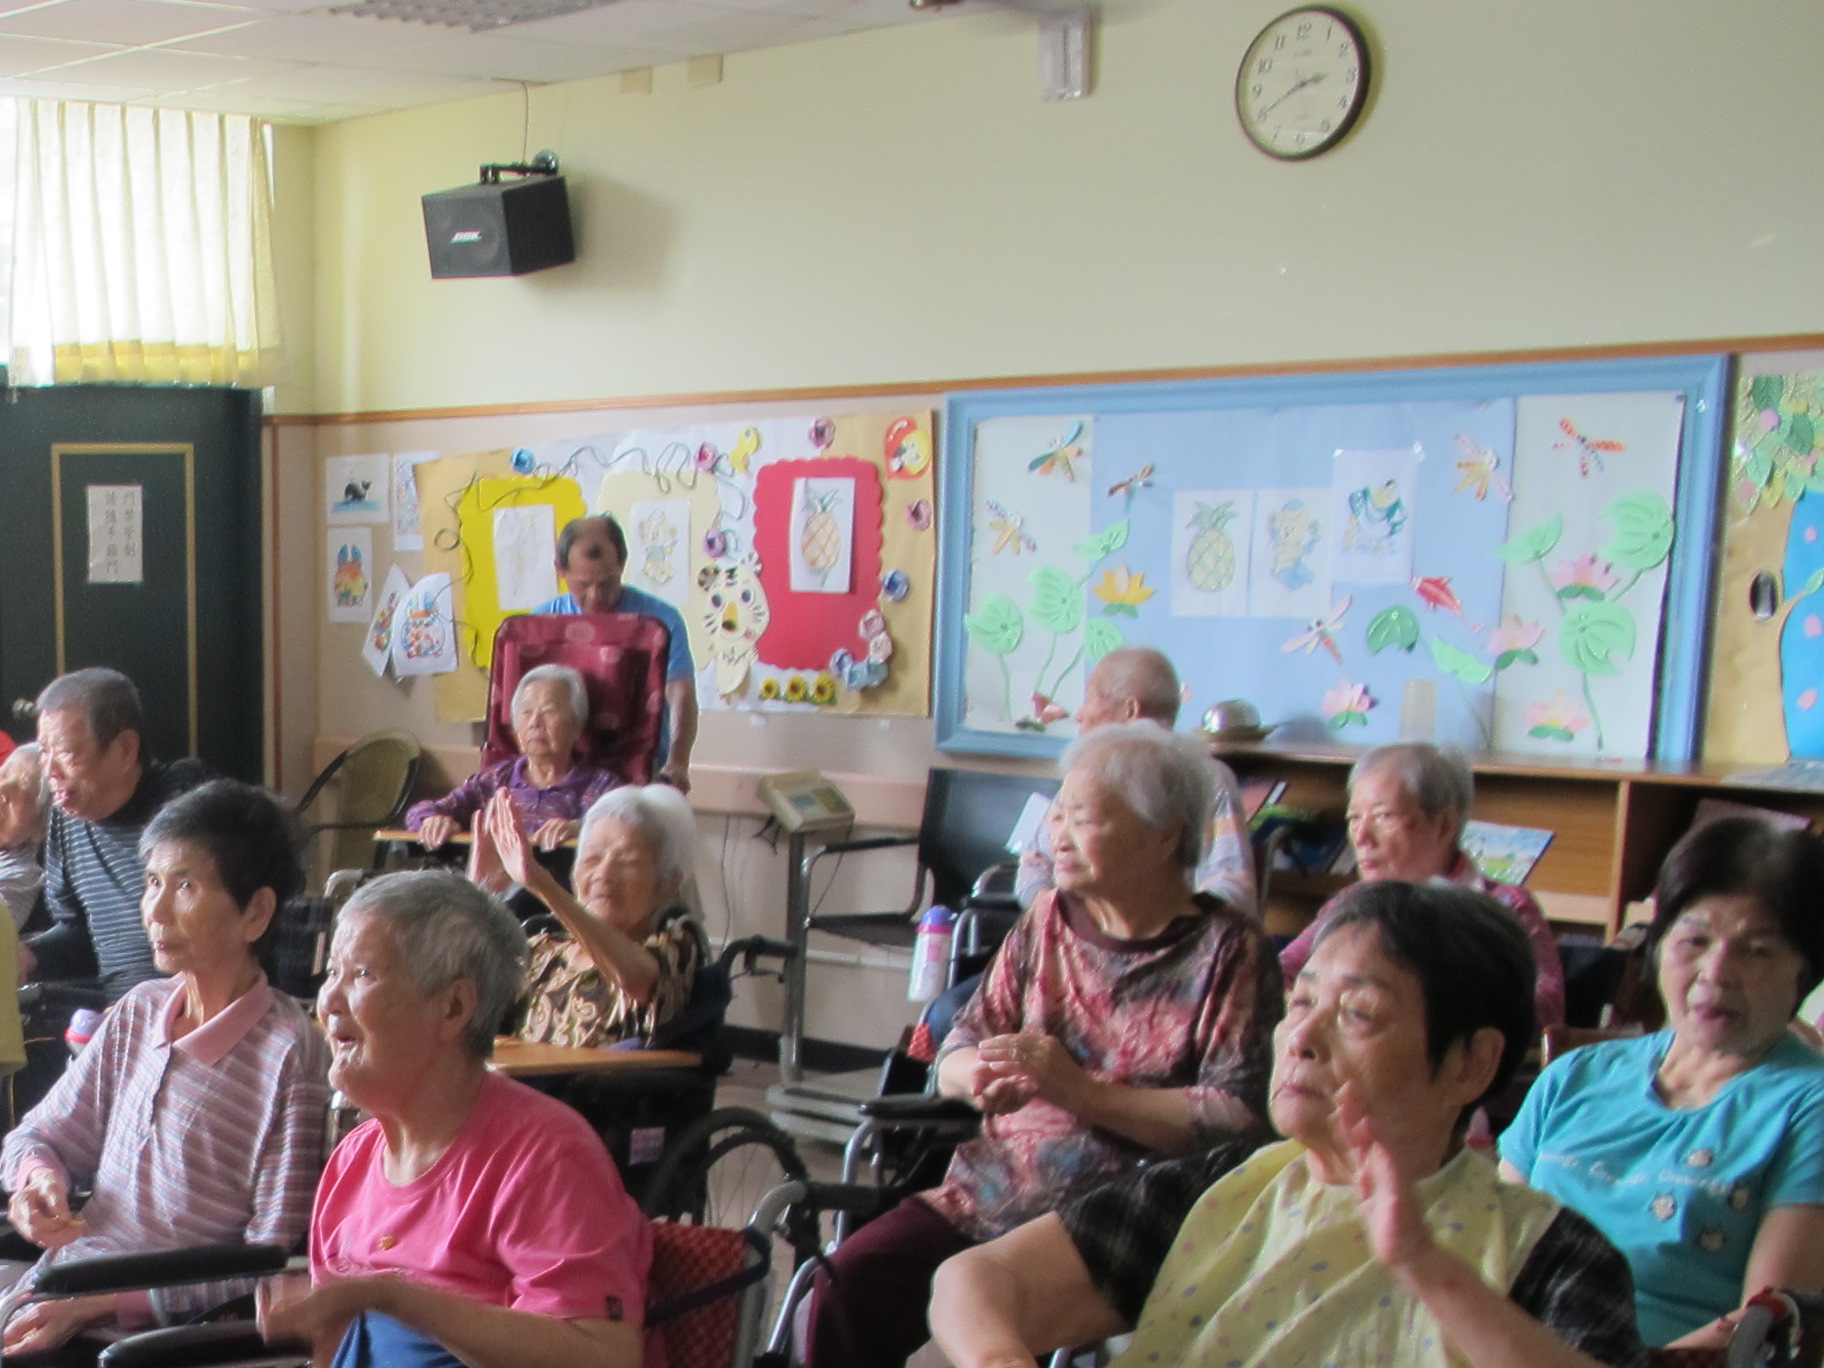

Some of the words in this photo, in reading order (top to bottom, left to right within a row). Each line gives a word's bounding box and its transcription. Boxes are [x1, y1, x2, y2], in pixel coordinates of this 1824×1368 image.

[1295, 23, 1312, 40] 12
[1274, 34, 1286, 50] 11
[1338, 41, 1350, 57] 2
[1258, 58, 1273, 74] 10
[1345, 67, 1357, 83] 3
[1251, 83, 1262, 99] 9
